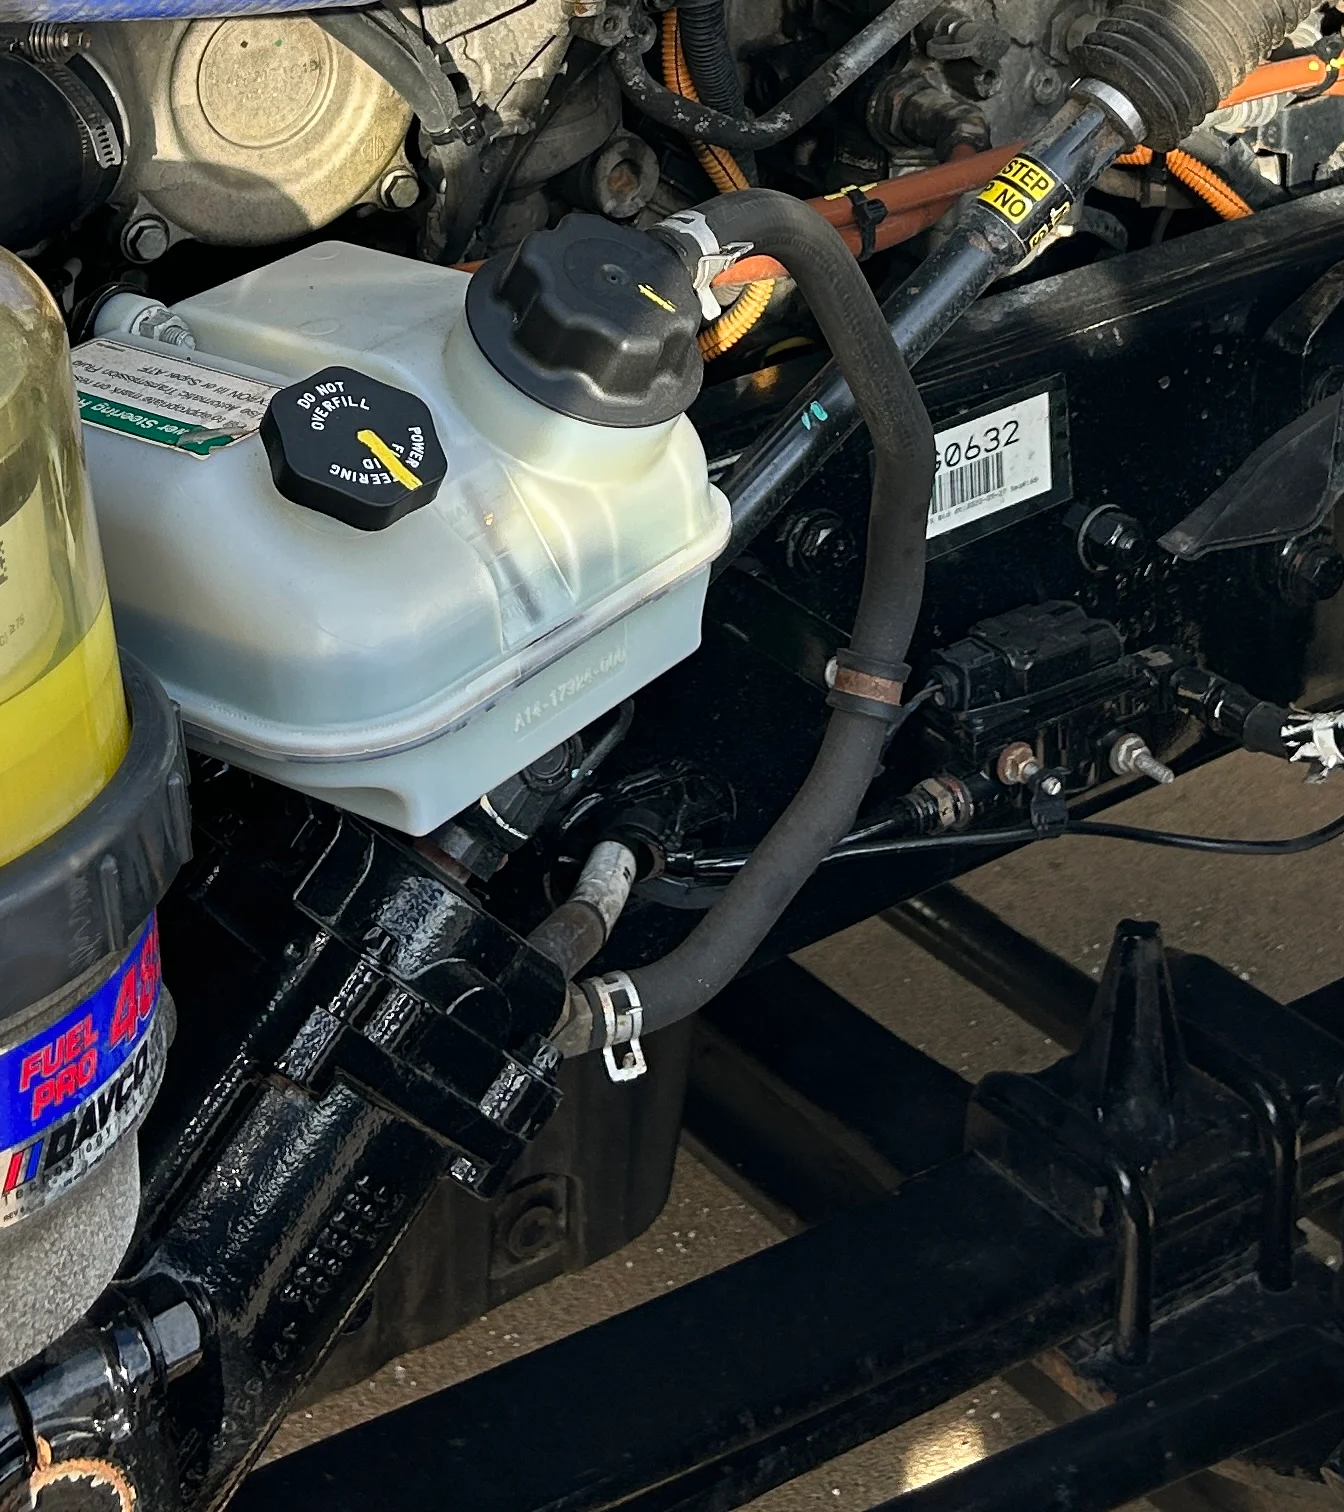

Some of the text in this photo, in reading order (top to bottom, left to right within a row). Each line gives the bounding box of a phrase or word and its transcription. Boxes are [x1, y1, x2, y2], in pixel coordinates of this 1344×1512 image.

[1001, 159, 1049, 192] STEP
[993, 189, 1026, 217] NO
[102, 368, 177, 396] Transmission
[137, 366, 167, 376] ATF
[167, 372, 202, 386] Super
[297, 381, 345, 410] DO NOT
[91, 402, 159, 430] Steering
[311, 395, 371, 431] OVERFILL
[406, 426, 425, 469] POWER
[329, 464, 400, 485] TEERING
[109, 929, 161, 1054] 48
[19, 1012, 99, 1094] FUEL
[30, 1047, 99, 1122] PRO
[43, 1040, 150, 1172] DAVCO
